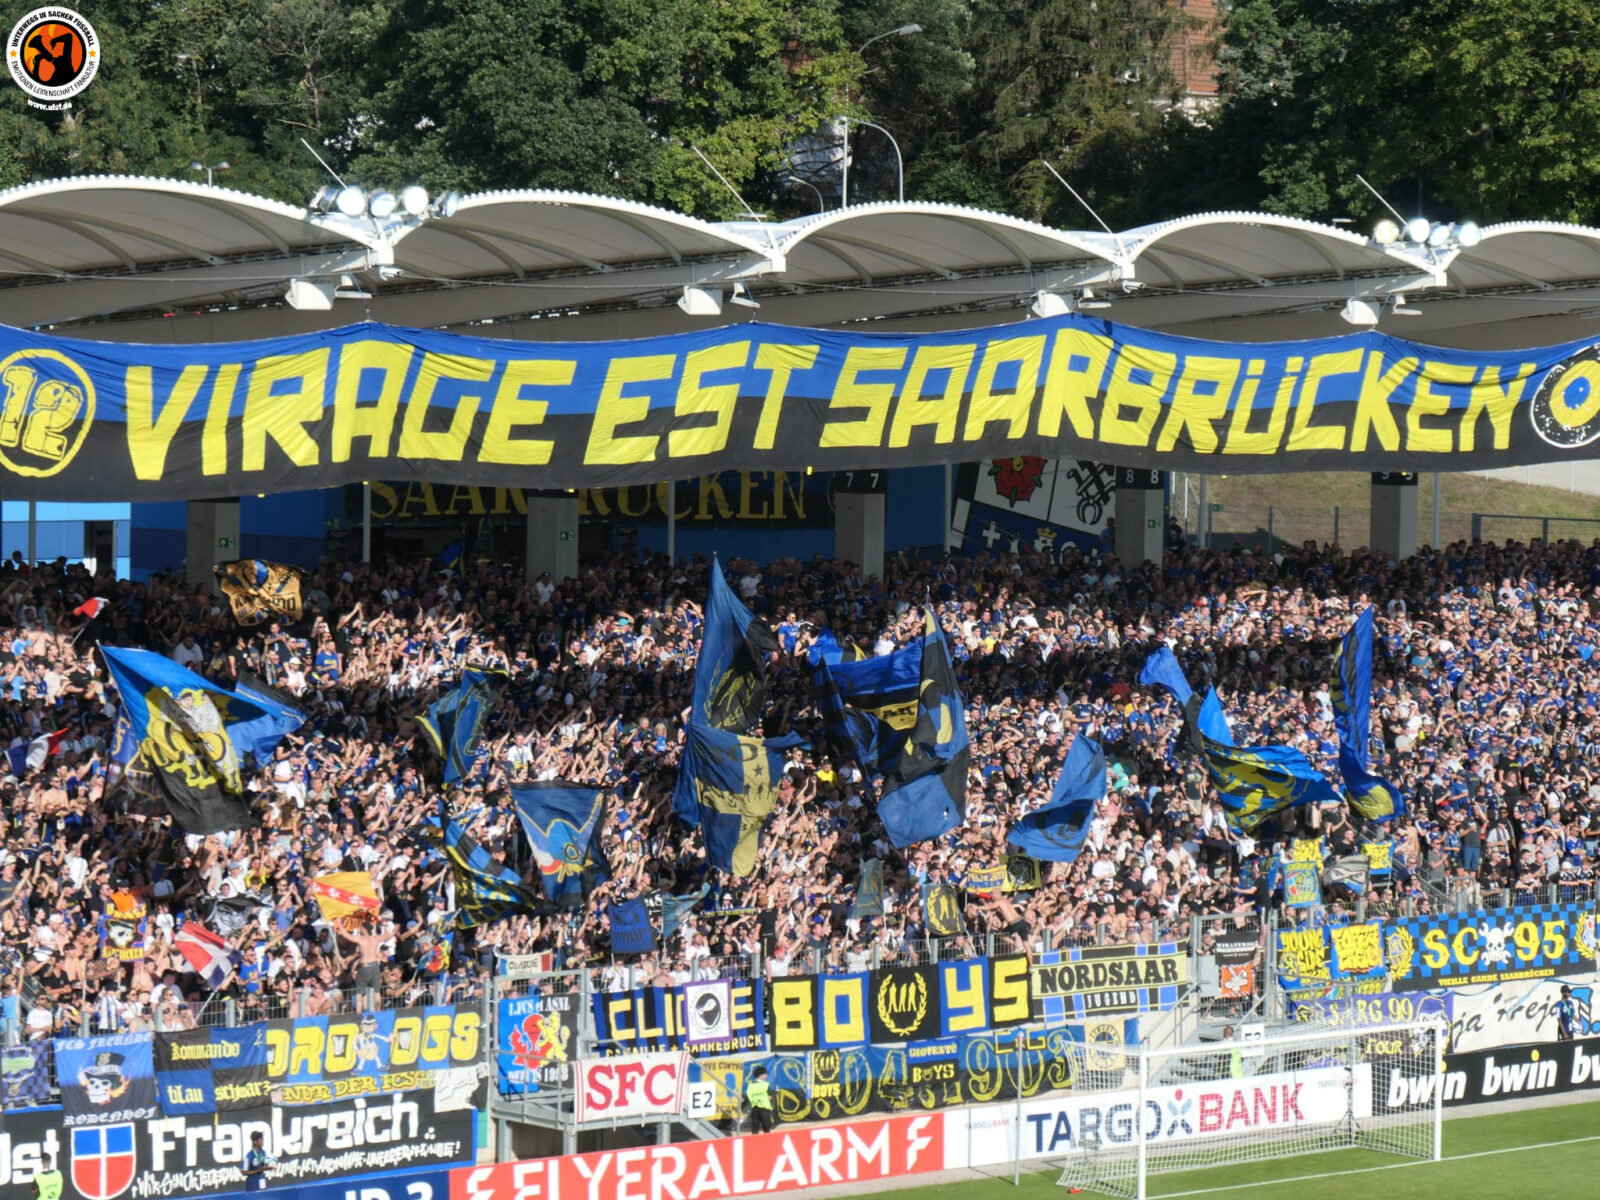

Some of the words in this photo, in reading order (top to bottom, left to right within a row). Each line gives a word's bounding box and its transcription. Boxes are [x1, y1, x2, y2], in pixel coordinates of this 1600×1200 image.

[125, 340, 577, 480] VIRAGE
[583, 340, 818, 466] EST
[819, 327, 1536, 455] SAARBRÜCKEN
[870, 472, 880, 488] 7
[1424, 926, 1479, 969] SC
[1513, 919, 1567, 961] 95
[1038, 958, 1179, 994] NORDSAAR
[1086, 990, 1137, 1009] JUGEND
[283, 1084, 332, 1103] NUR
[334, 1076, 378, 1096] DER
[381, 1070, 416, 1090] FCS
[586, 1062, 676, 1110] SFC
[1482, 1049, 1558, 1096] bwin
[692, 1090, 713, 1109] E2
